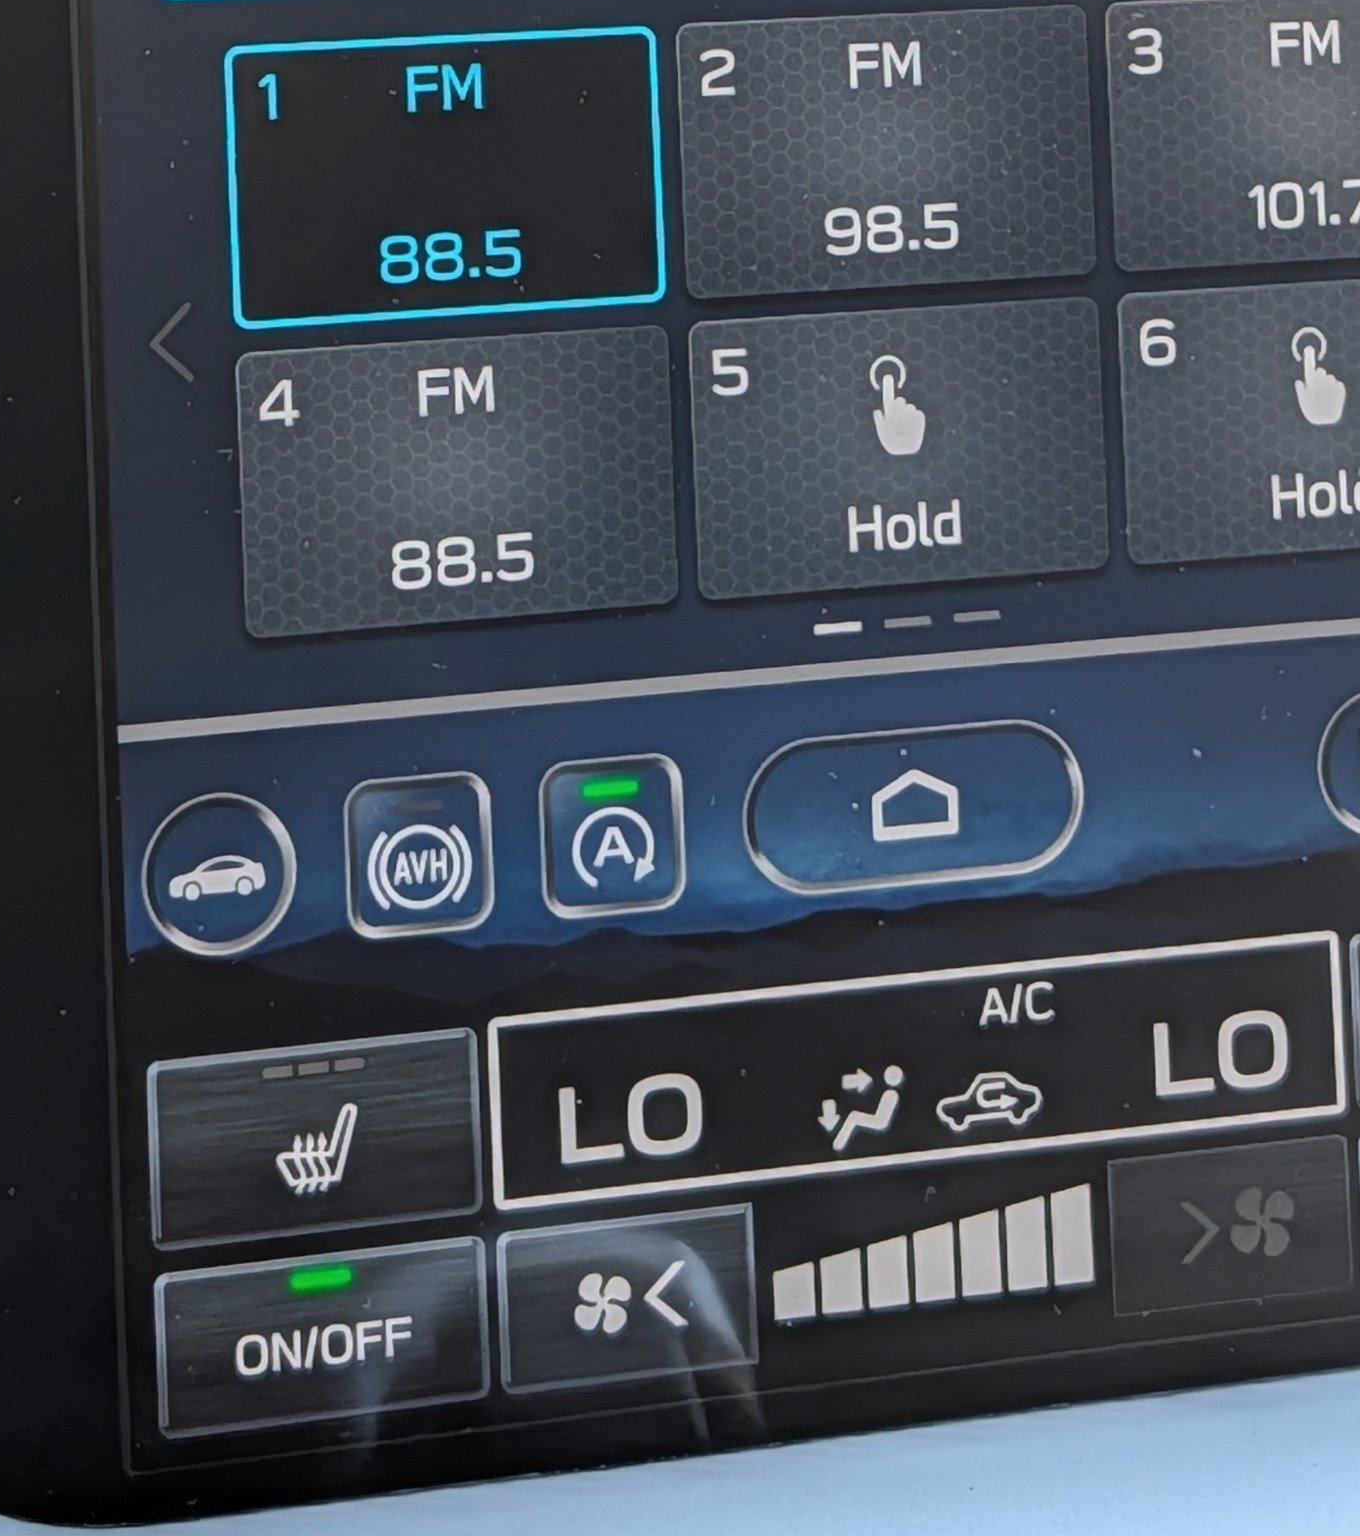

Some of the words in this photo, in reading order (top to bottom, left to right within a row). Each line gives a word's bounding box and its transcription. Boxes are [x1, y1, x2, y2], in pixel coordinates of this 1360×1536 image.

[848, 39, 924, 90] FM
[1127, 26, 1165, 76] 3
[1269, 18, 1341, 69] FM
[257, 72, 279, 121] 1
[404, 64, 485, 116] FM
[698, 47, 737, 97] 2
[823, 202, 961, 257] 98.5
[378, 229, 524, 285] 88.5
[1137, 318, 1178, 368] 6
[416, 365, 497, 419] FM
[711, 348, 750, 397] 5
[257, 379, 301, 429] 4
[847, 499, 964, 553] Hold
[390, 533, 536, 590] 88.5
[392, 840, 449, 888] AVH
[978, 982, 1056, 1028] A/C
[1153, 1010, 1292, 1101] LO
[558, 1074, 705, 1167] LO
[235, 1315, 414, 1378] ON/OFF
